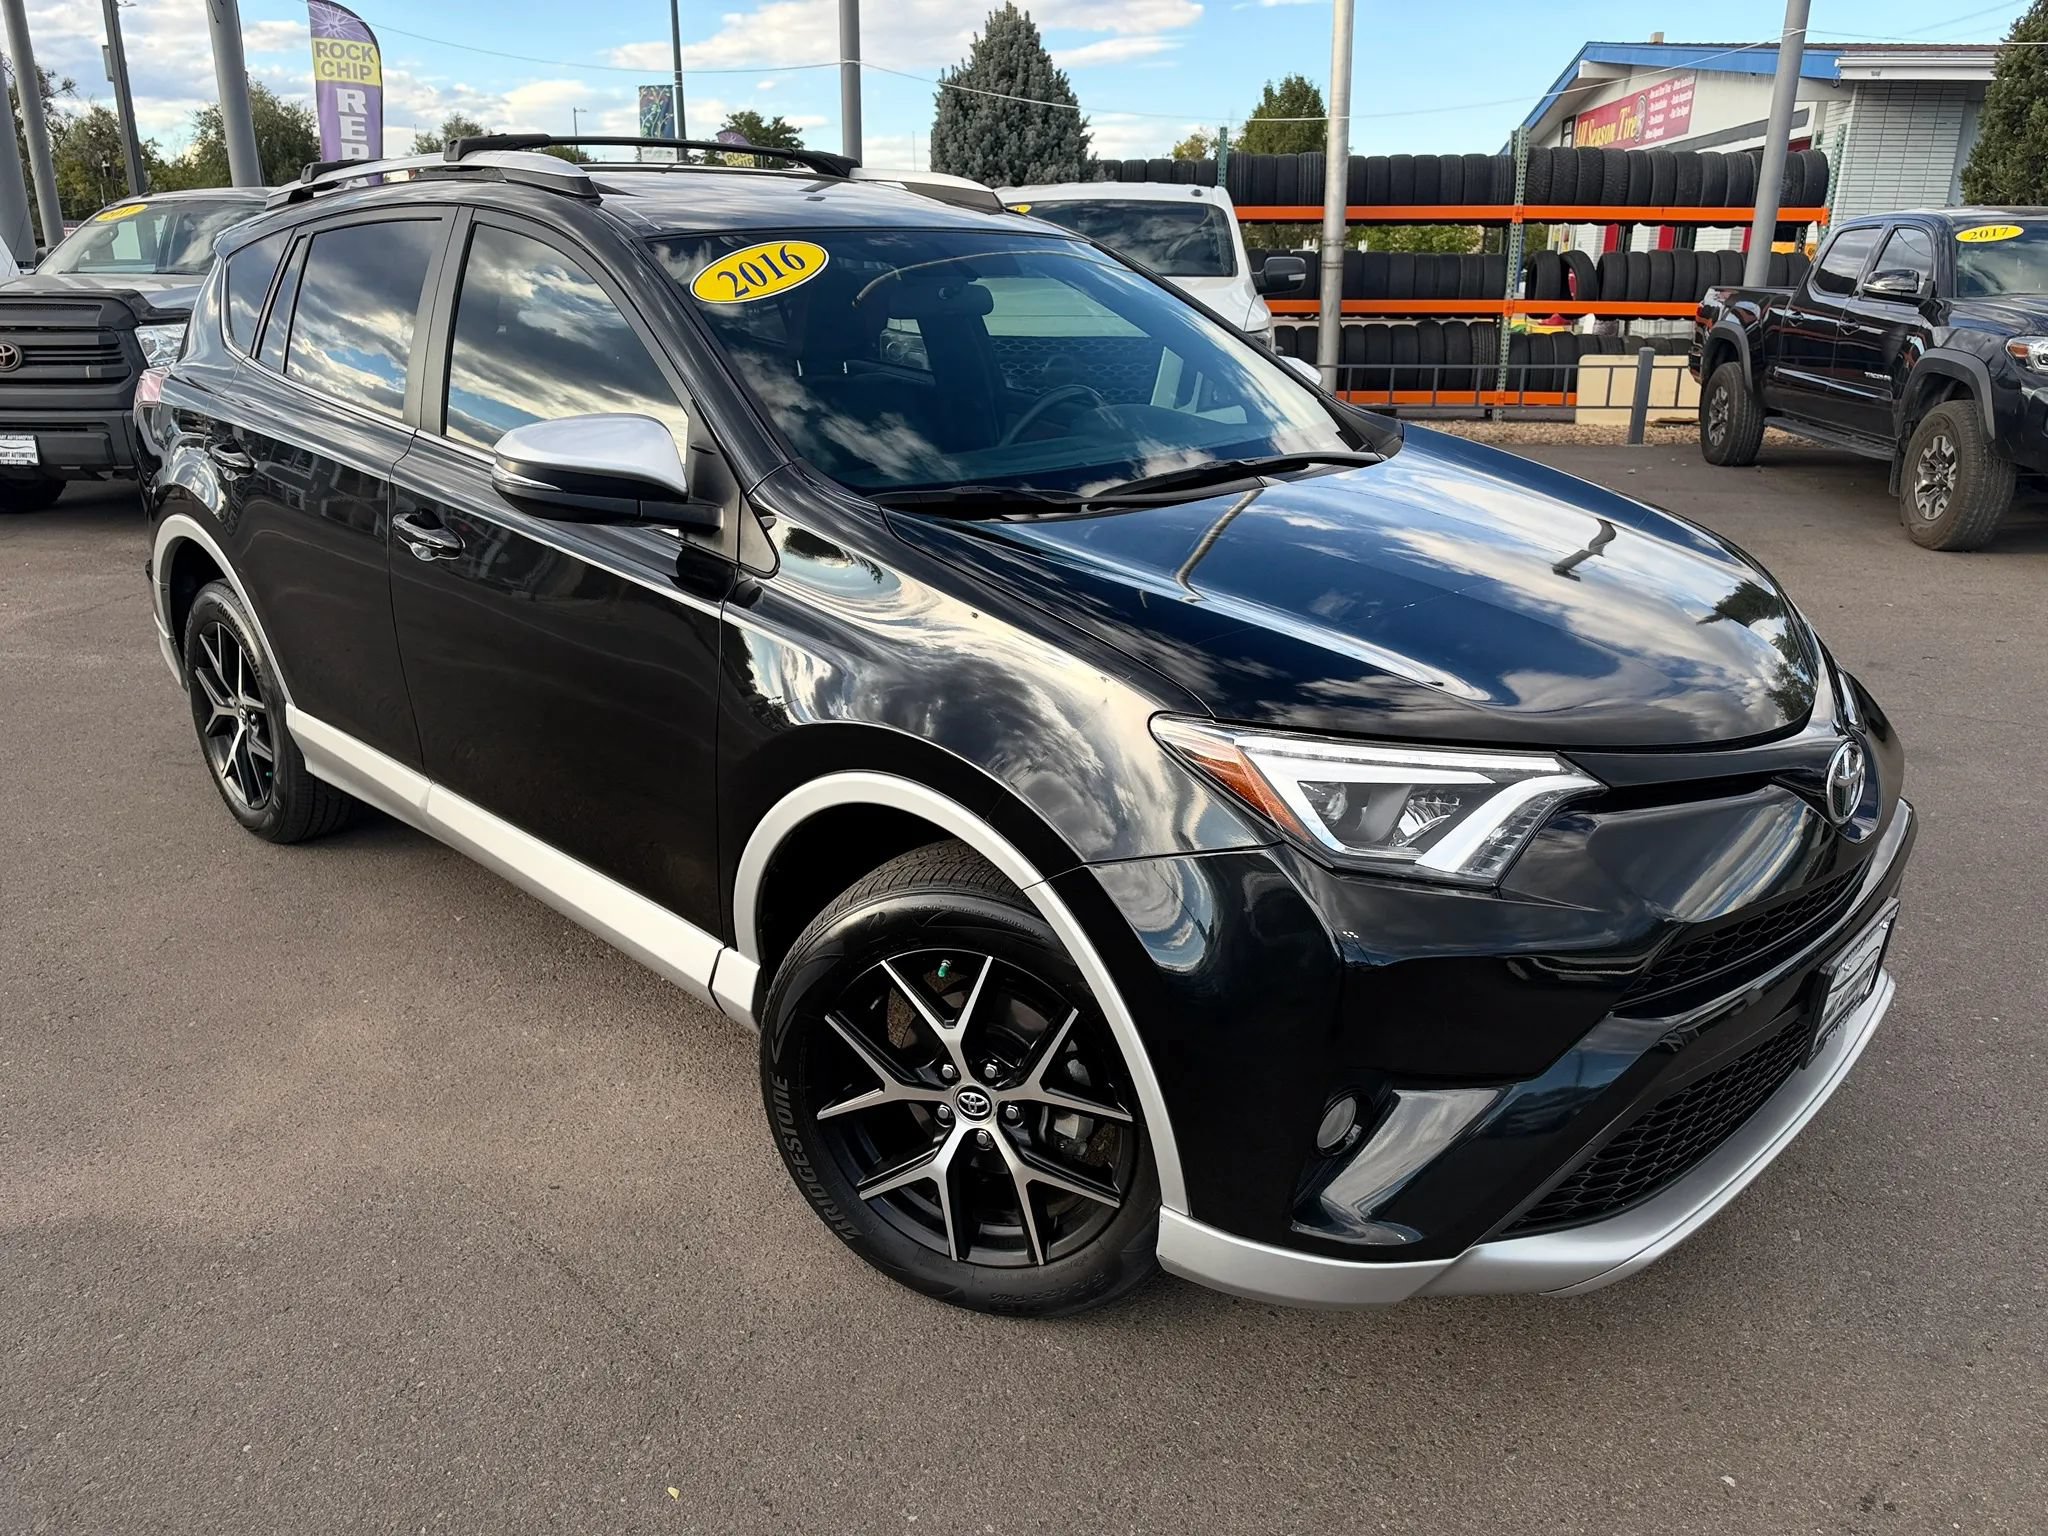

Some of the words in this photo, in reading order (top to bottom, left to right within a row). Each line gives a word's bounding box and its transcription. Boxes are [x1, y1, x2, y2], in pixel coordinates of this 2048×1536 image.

[315, 41, 374, 63] ROCK
[320, 60, 372, 81] CHIP
[1588, 119, 1617, 147] Season
[1968, 226, 2009, 241] 2017
[717, 244, 806, 298] 2016
[769, 1071, 864, 1240] BRIDGESTONE
